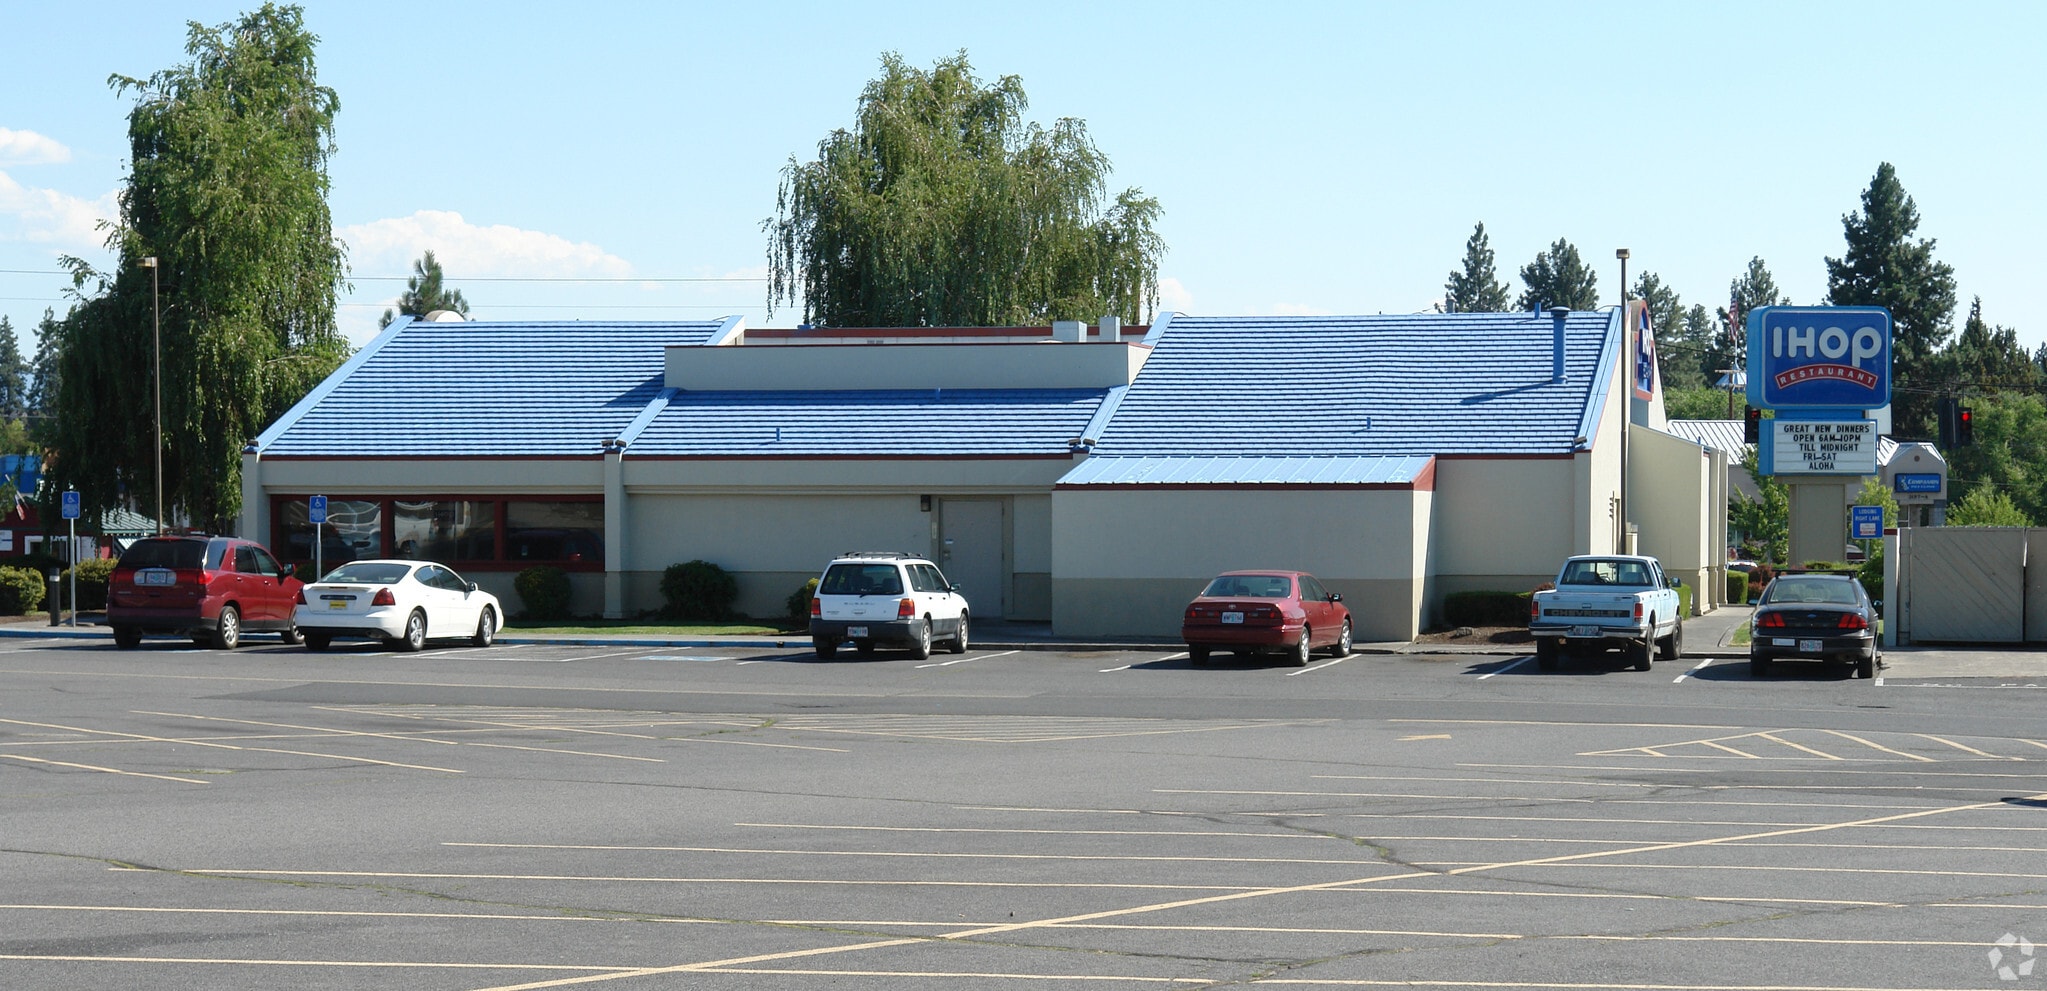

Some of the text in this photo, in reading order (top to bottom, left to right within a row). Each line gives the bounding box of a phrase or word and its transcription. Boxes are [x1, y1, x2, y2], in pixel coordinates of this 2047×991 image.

[1772, 326, 1882, 368] IHOP
[1780, 367, 1873, 385] RESTAURANT
[1784, 425, 1870, 433] GREAT NEW DINNERS
[1793, 434, 1815, 442] OPEN
[1799, 443, 1859, 451] TILL MIDNIGHT
[1803, 452, 1837, 460] FRI-SAT
[1808, 462, 1835, 470] ALOHA
